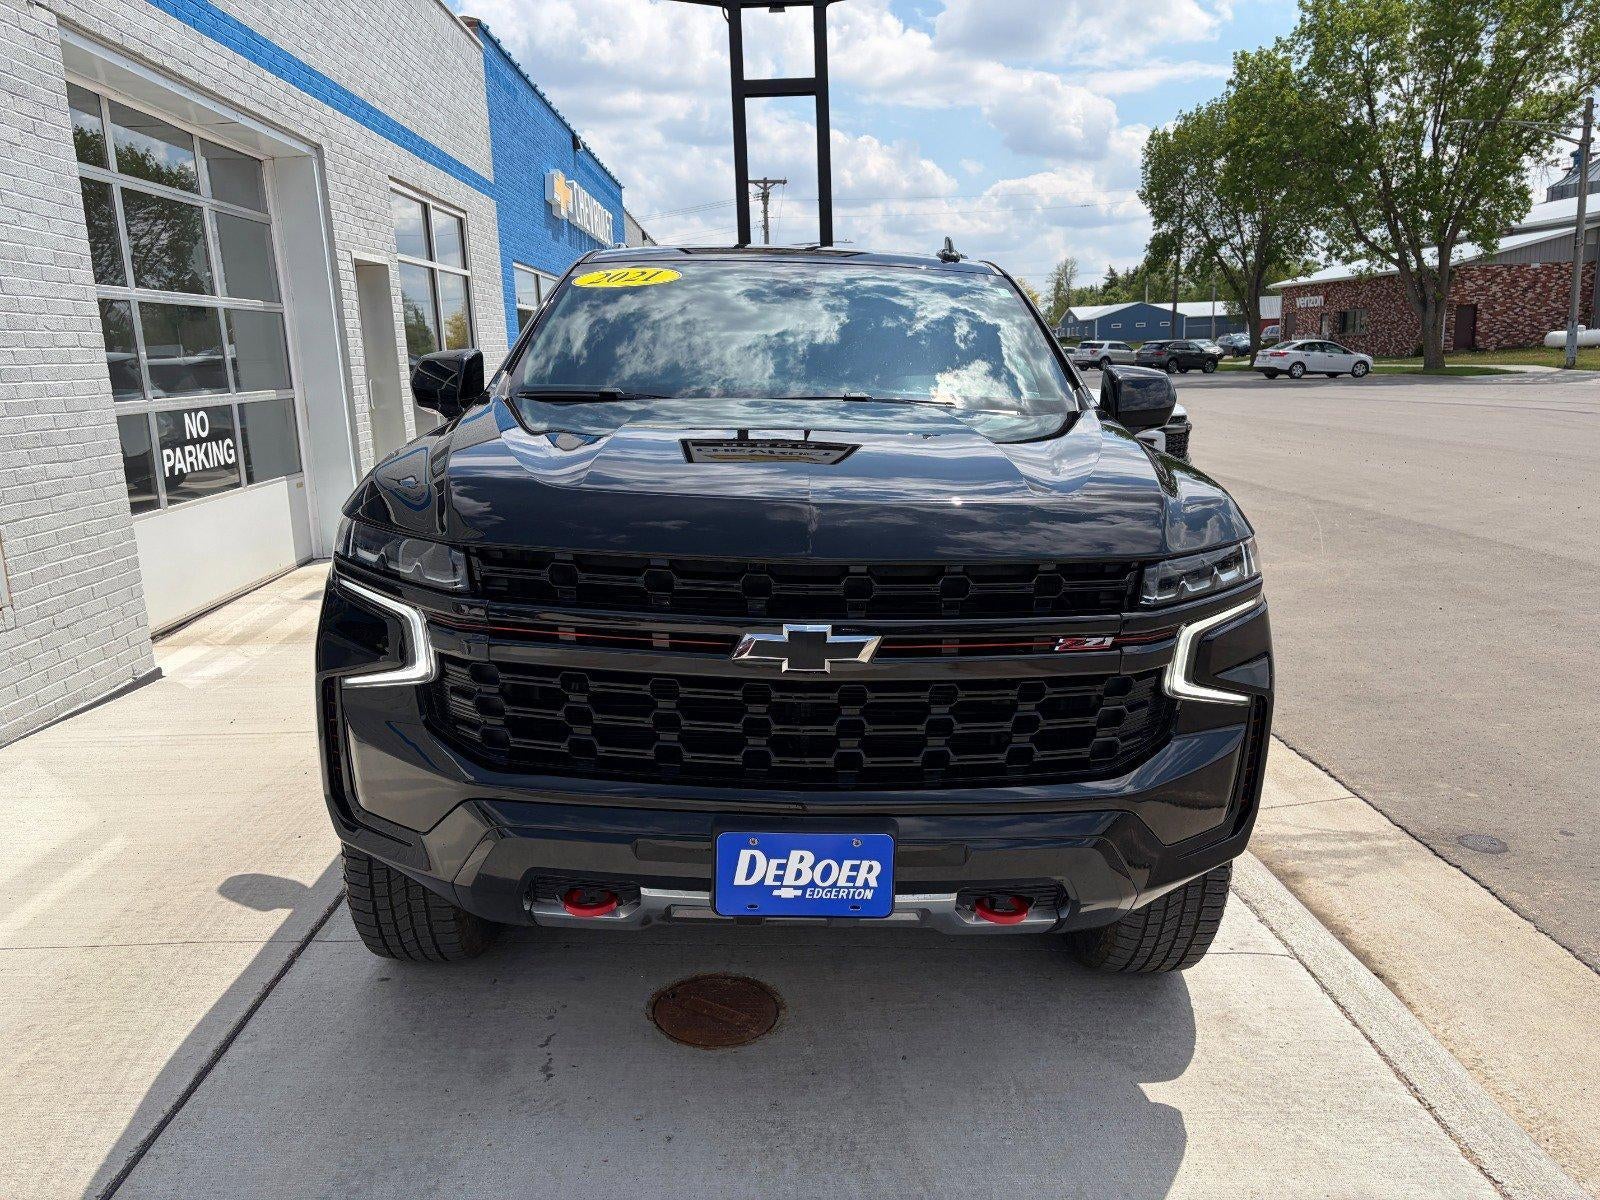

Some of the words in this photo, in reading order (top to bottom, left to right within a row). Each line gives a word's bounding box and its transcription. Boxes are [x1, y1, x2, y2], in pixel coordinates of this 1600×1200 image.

[587, 270, 664, 285] 2021
[1295, 294, 1325, 309] verizon
[183, 410, 210, 440] NO
[162, 438, 236, 478] PARKING
[805, 887, 874, 900] EDGERTON
